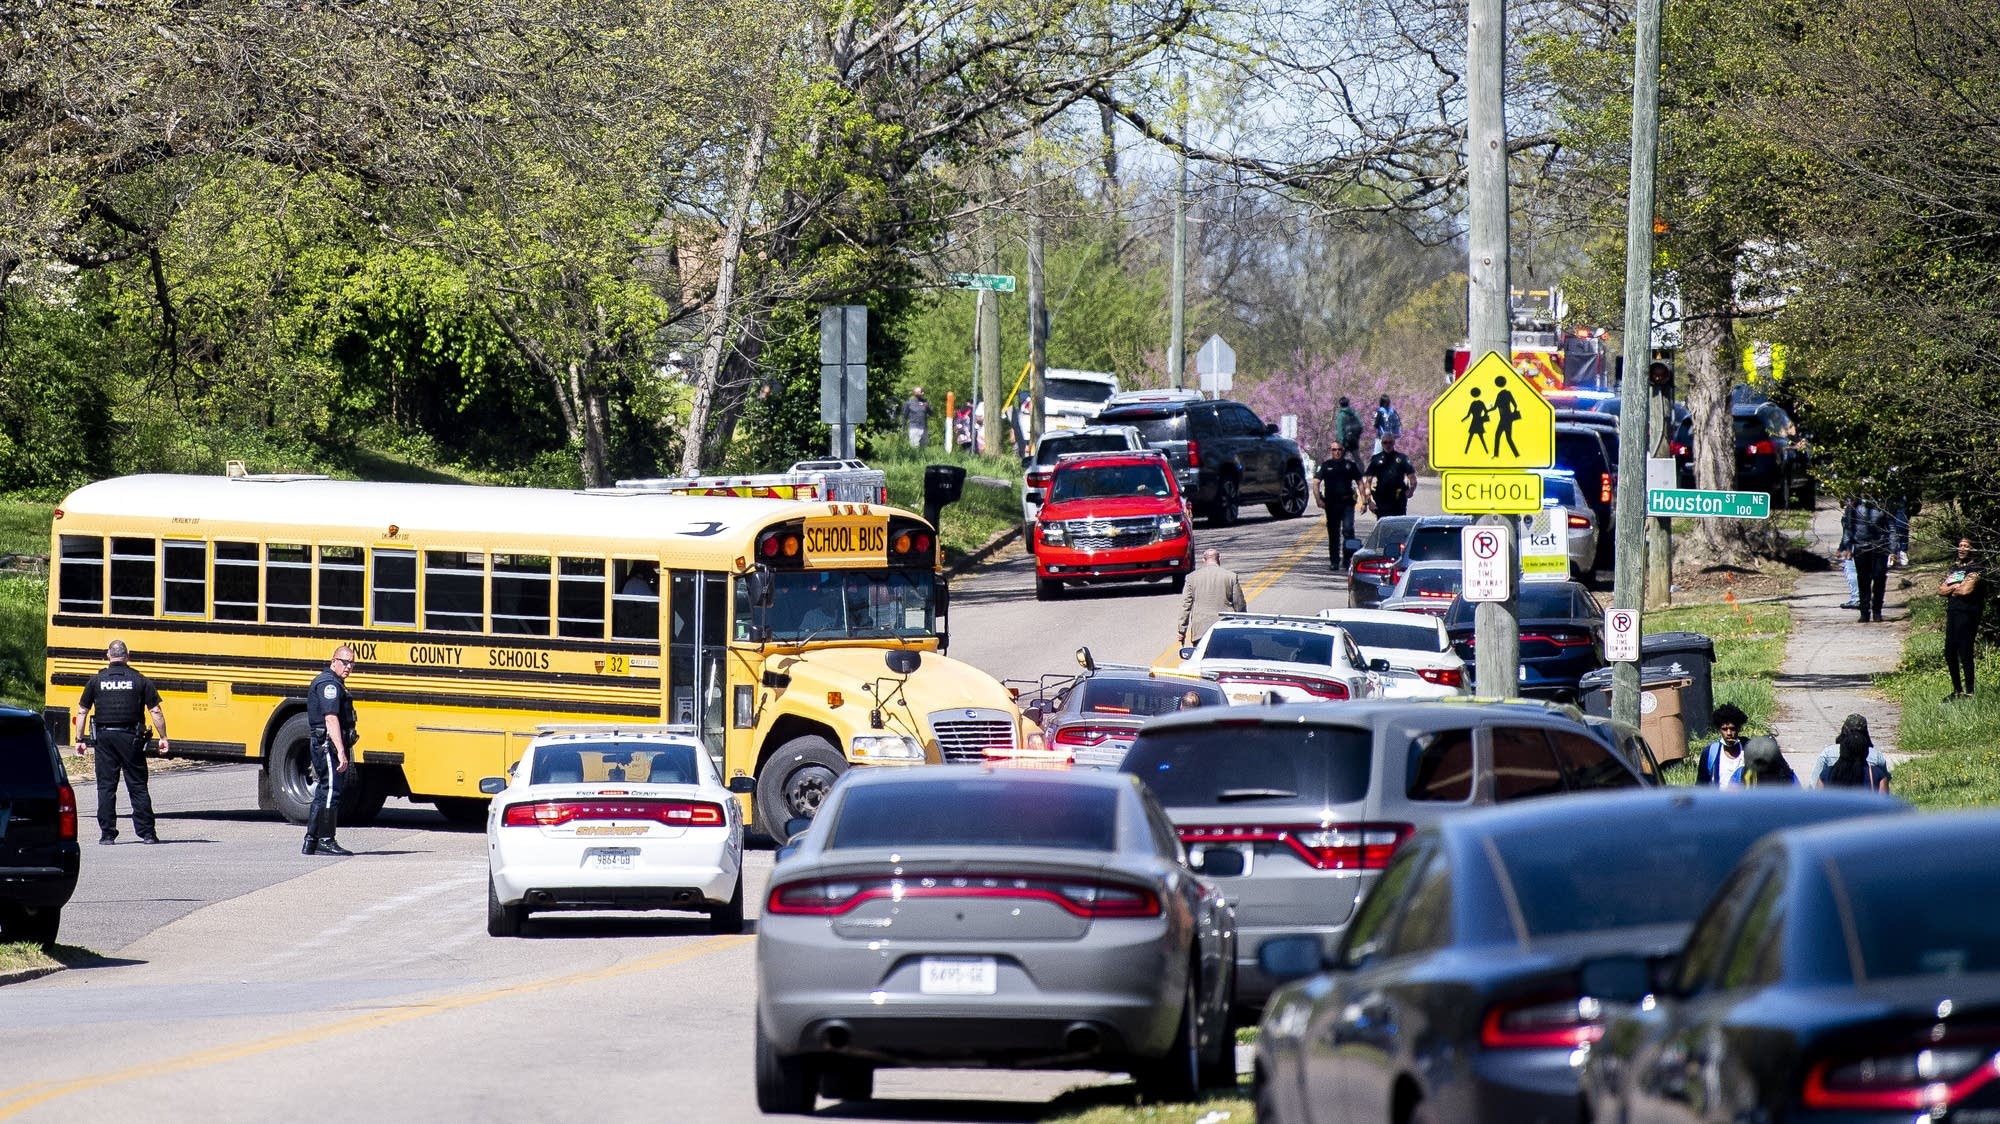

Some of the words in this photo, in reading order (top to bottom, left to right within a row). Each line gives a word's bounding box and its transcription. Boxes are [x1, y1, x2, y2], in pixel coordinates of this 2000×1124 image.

[1451, 483, 1535, 501] SCHOOL
[1652, 492, 1723, 513] Houston
[1725, 494, 1737, 504] ST
[1752, 495, 1764, 505] NE
[1736, 505, 1752, 515] 100
[806, 526, 856, 553] SCHOOL
[859, 526, 884, 552] BUS
[1530, 533, 1557, 546] kat
[1478, 569, 1493, 578] TIME
[1469, 579, 1481, 587] TOW
[1485, 579, 1503, 587] AWAY
[1478, 588, 1493, 597] ZONE
[410, 646, 463, 665] COUNTY
[489, 649, 549, 670] SCHOOLS
[610, 656, 623, 672] 32
[100, 681, 133, 690] POLICE
